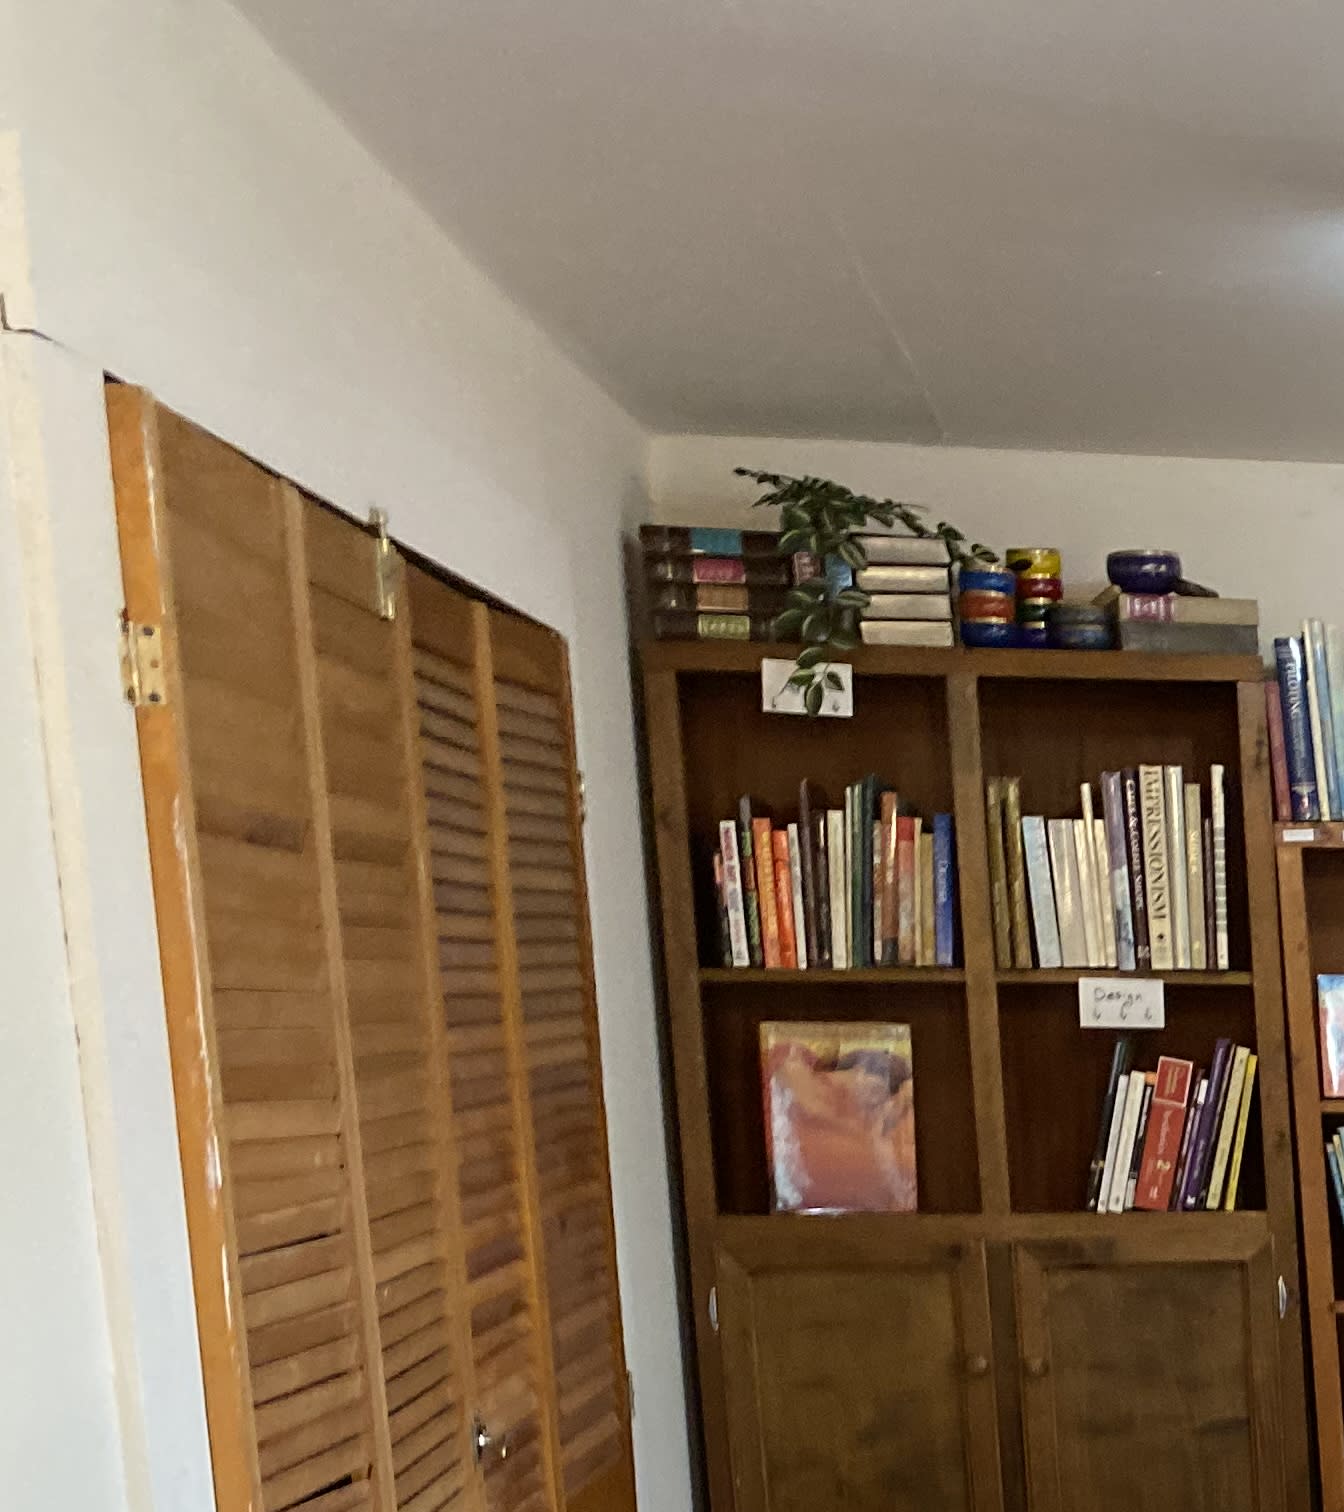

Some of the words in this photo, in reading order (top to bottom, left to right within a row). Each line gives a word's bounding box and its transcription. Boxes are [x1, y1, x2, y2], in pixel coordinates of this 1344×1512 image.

[1130, 831, 1142, 871] COFFEE
[1142, 769, 1168, 921] IMPRESSIONISM
[1094, 987, 1143, 1008] Design
